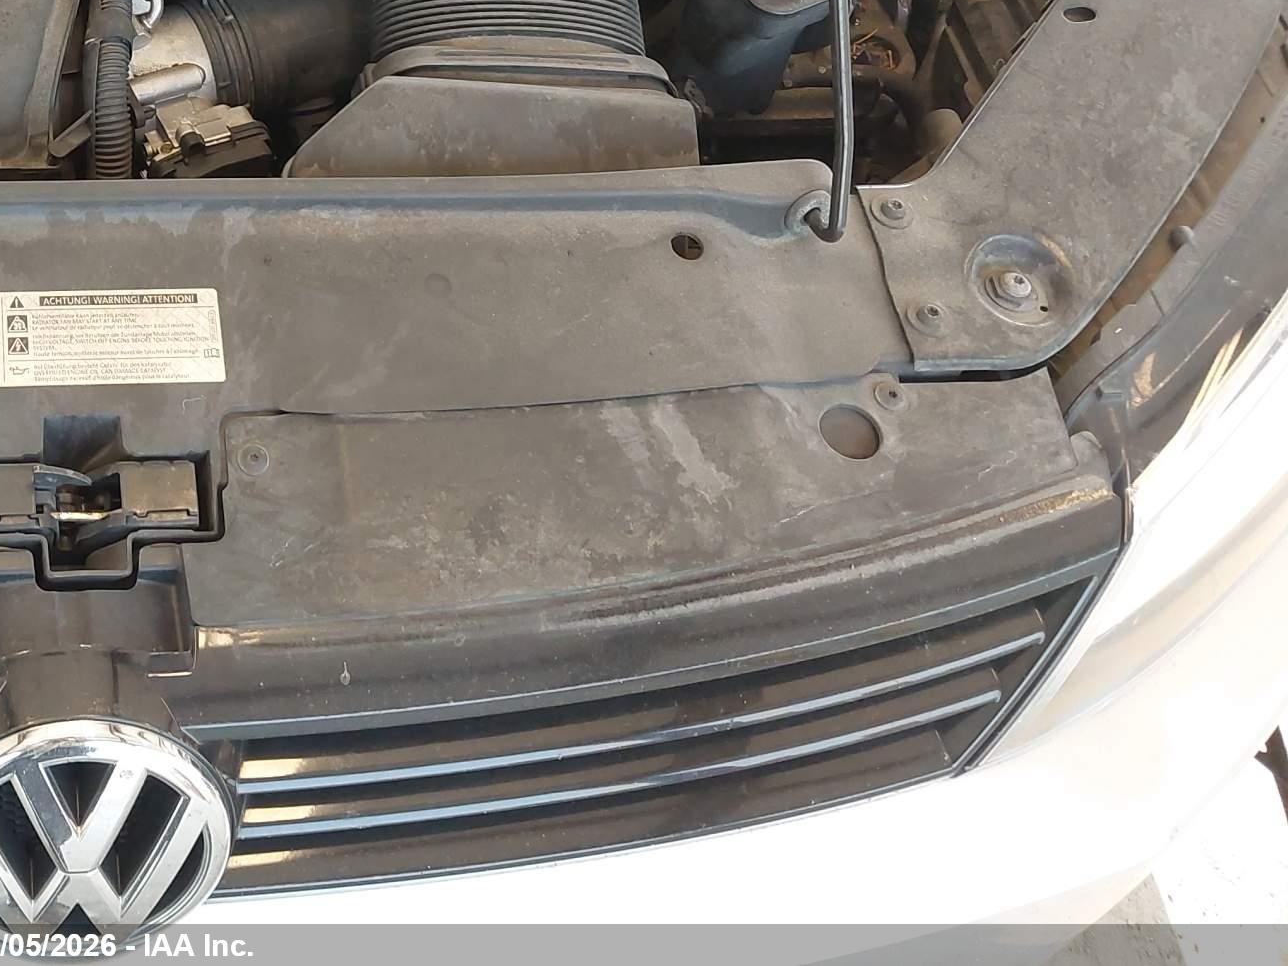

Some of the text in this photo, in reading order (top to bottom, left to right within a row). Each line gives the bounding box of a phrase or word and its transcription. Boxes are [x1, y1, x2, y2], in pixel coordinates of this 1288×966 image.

[43, 294, 195, 305] ACHTUNG! WARNING! ATTENTION!
